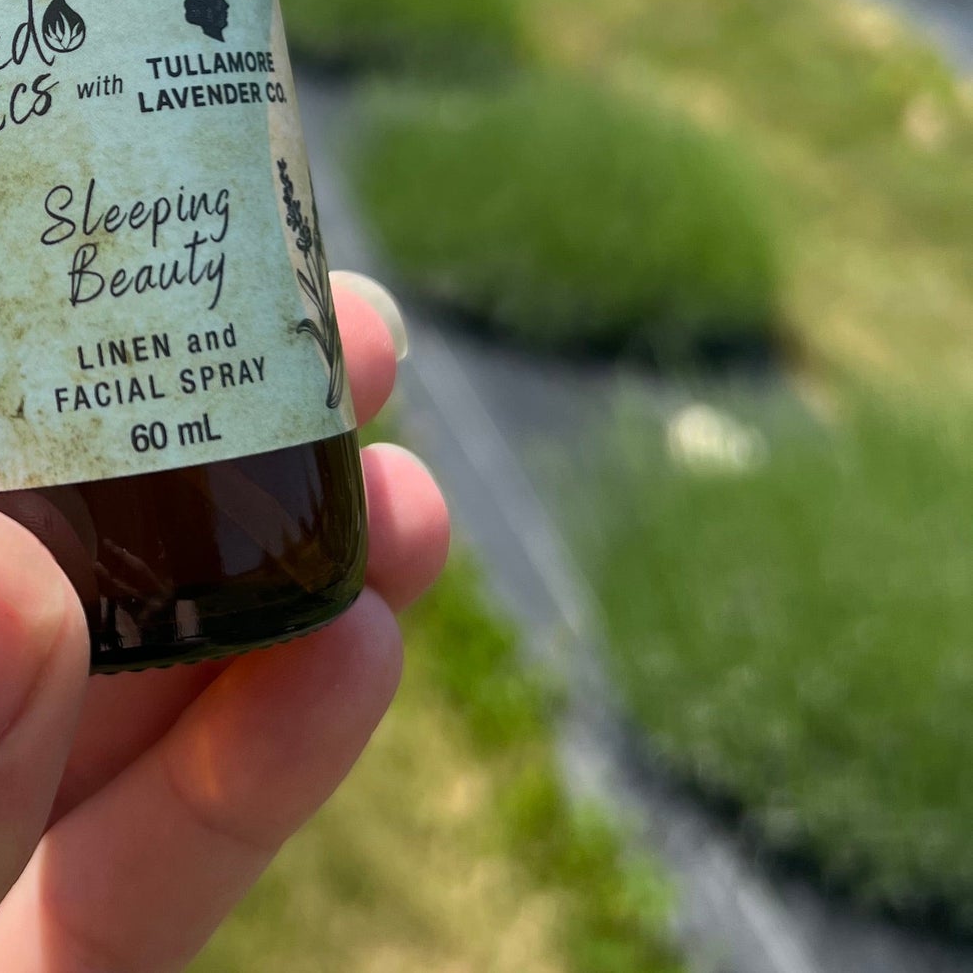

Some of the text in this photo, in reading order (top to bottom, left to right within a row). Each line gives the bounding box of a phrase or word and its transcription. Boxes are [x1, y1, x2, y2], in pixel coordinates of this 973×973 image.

[76, 74, 124, 100] with
[145, 51, 275, 80] TULLAMORE
[137, 81, 287, 114] LAVENDER CO.
[40, 178, 230, 247] Sleeping
[67, 230, 226, 311] Beauty
[77, 323, 237, 370] LINEN and
[54, 356, 266, 413] FACIAL SPRAY
[130, 413, 222, 453] 60 mL
